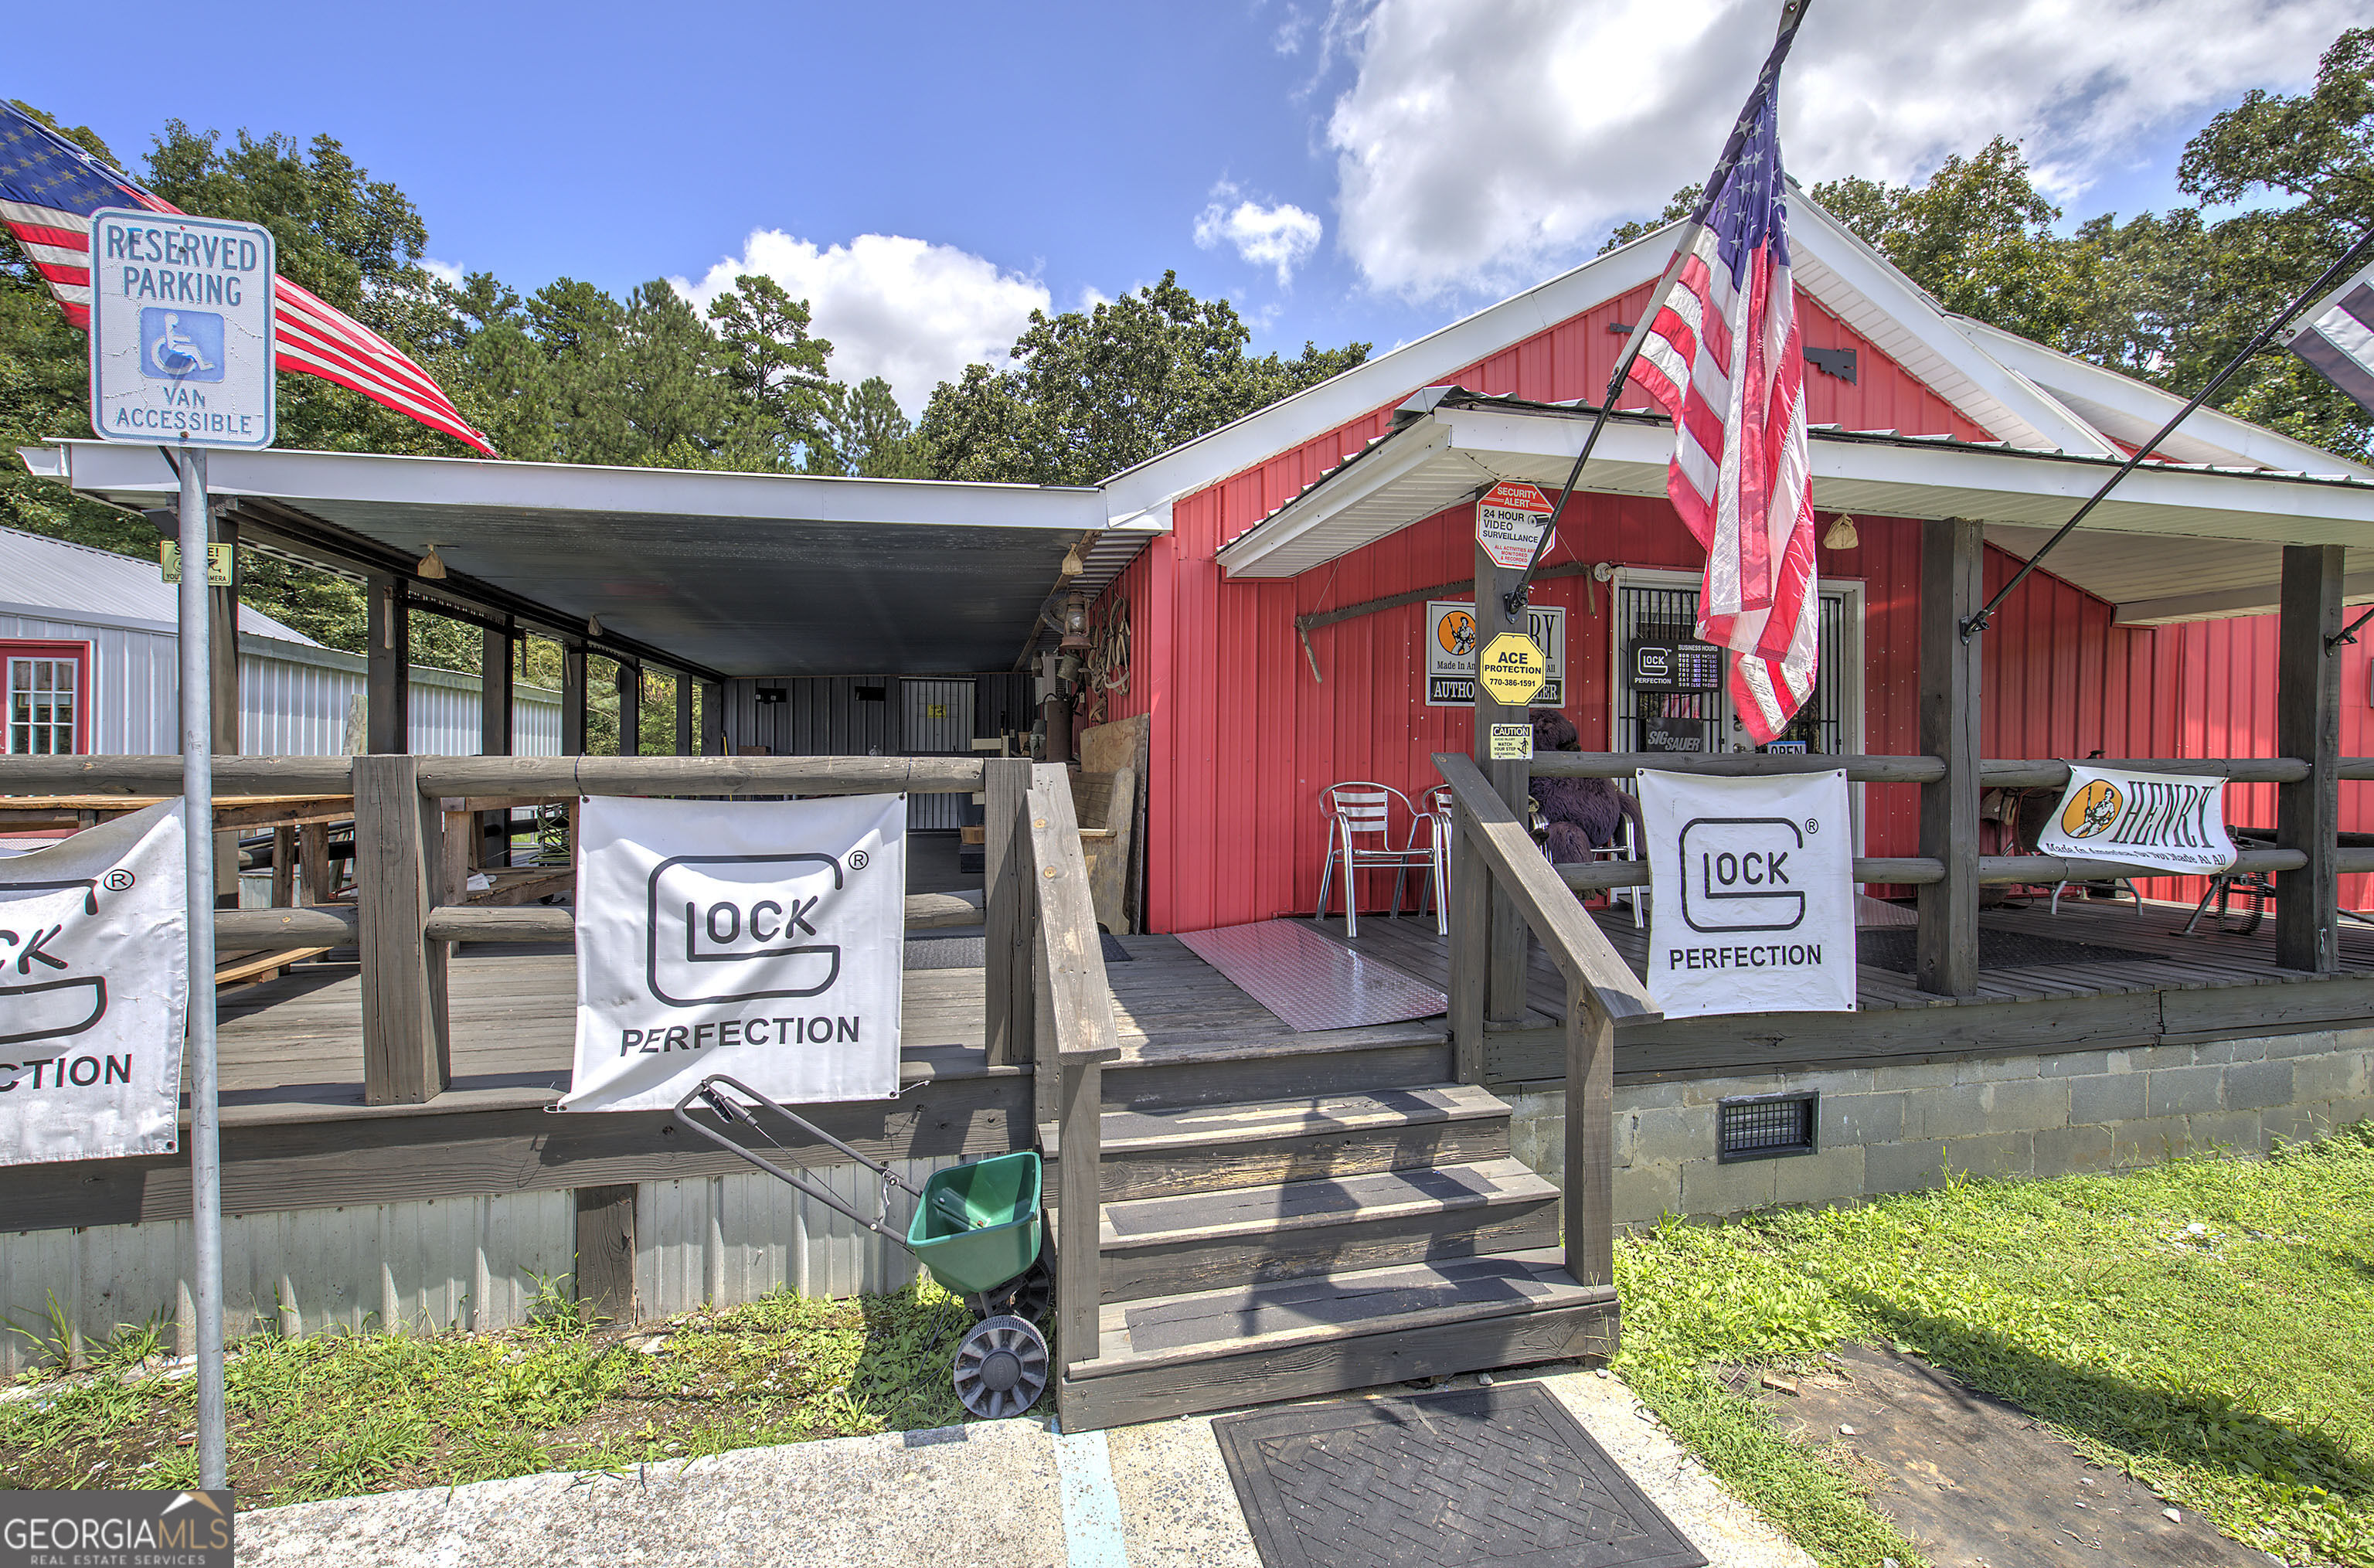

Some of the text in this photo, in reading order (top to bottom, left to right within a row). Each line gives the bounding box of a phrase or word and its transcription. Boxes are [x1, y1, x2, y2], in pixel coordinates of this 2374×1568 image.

[107, 223, 257, 272] RESERVED
[123, 266, 241, 307] PARKING
[163, 386, 206, 408] VAN
[116, 407, 252, 434] ACCESSIBLE
[1497, 487, 1537, 499] SECURITY
[1504, 497, 1530, 508] ALERT
[1484, 509, 1525, 522] 24 HOUR
[1484, 519, 1513, 531] VIDEO
[1483, 530, 1538, 543] SURVEILLANCE
[1498, 651, 1528, 665] ACE
[1437, 661, 1456, 669] Made
[1457, 662, 1464, 670] In
[1485, 665, 1542, 675] PROTECTION
[1434, 681, 1475, 698] AUTHO
[1489, 678, 1536, 687] 770-386-1591
[1494, 727, 1529, 736] CAUTION
[1648, 730, 1668, 745] SIG
[1665, 736, 1700, 751] SAUER
[1771, 746, 1802, 754] OPEN
[2108, 781, 2215, 849] HENRY
[2198, 854, 2212, 865] At
[2212, 854, 2226, 866] All
[1669, 944, 1821, 970] PERFECTION
[619, 1015, 860, 1057] PERFECTION
[0, 1053, 132, 1092] CTION
